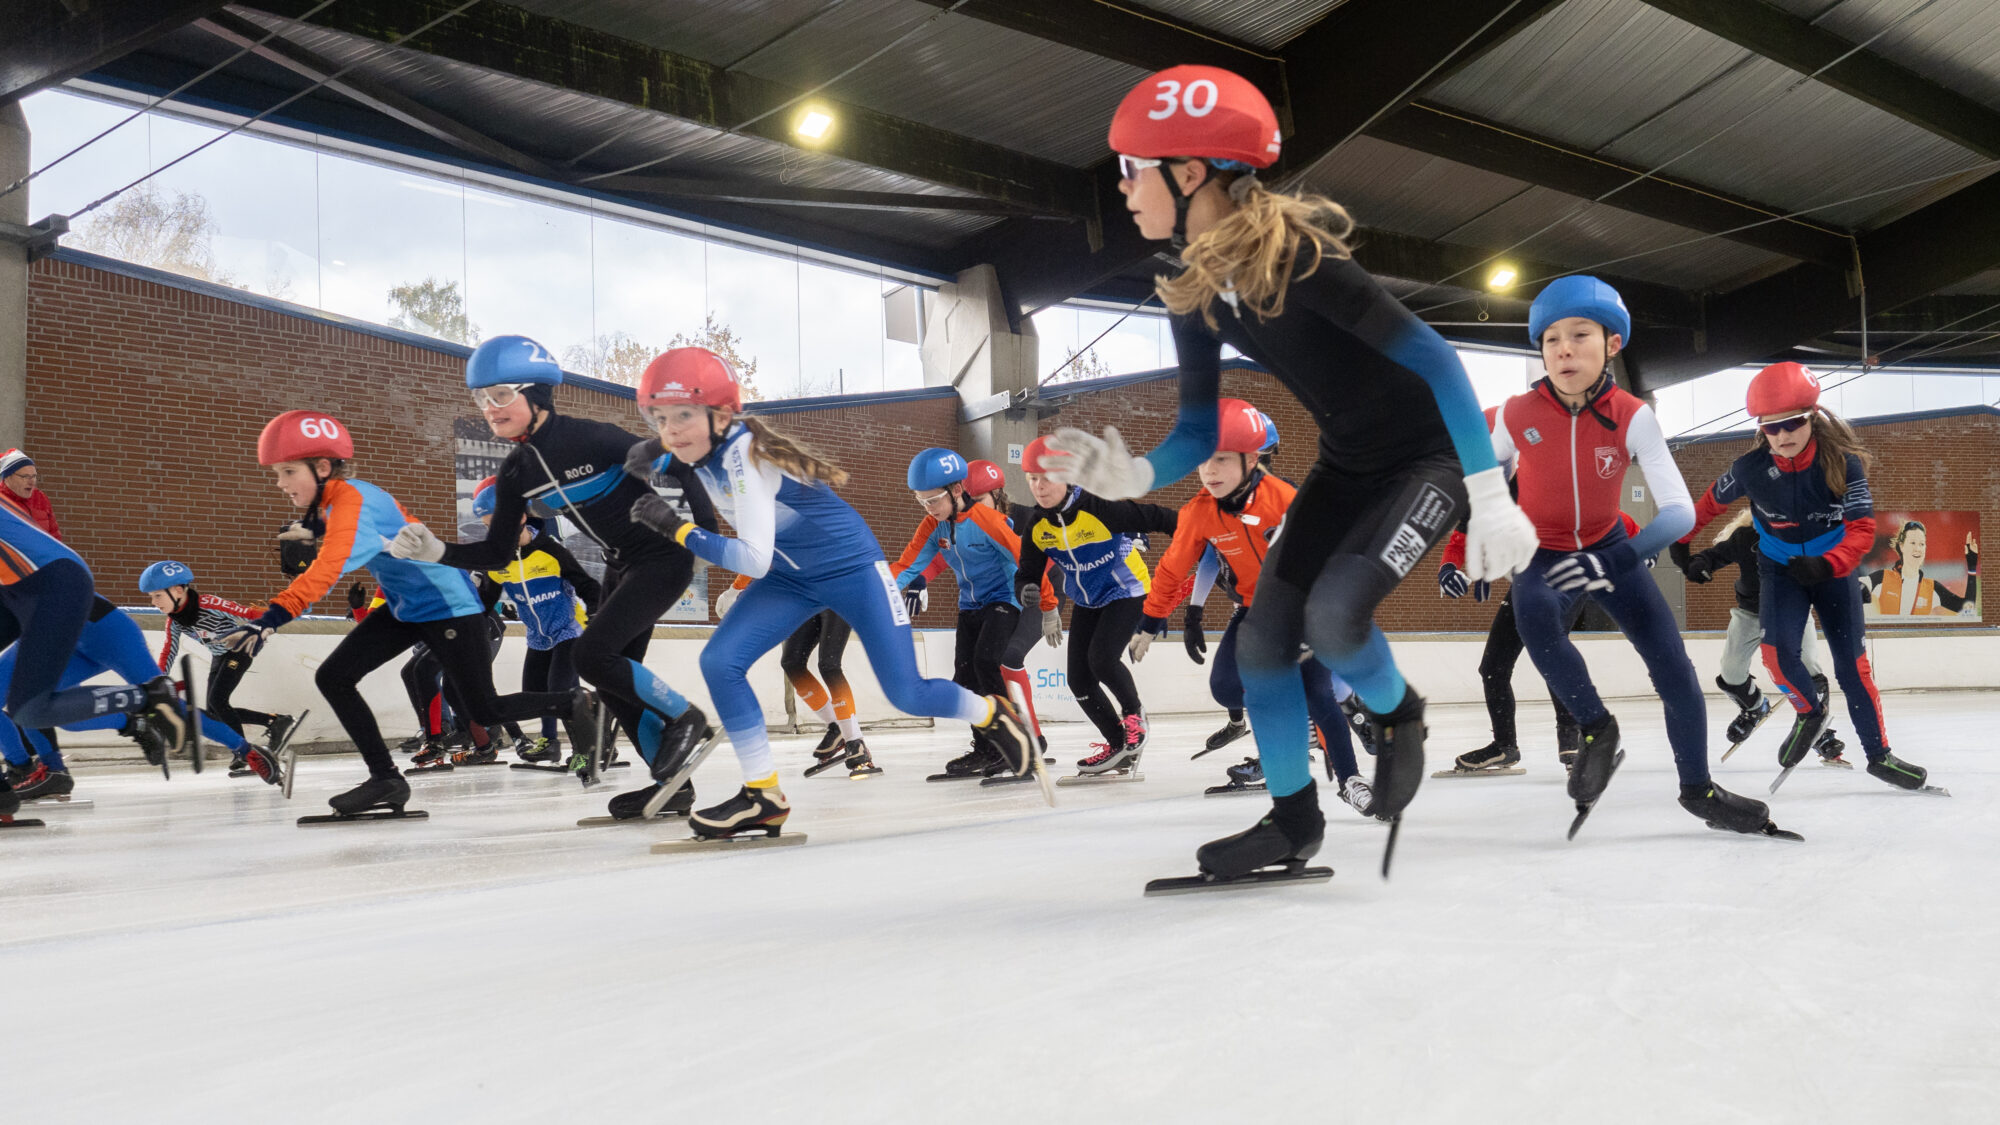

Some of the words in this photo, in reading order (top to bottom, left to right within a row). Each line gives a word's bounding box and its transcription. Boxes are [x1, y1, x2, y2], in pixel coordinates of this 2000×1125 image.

[1146, 79, 1218, 120] 30
[300, 417, 339, 439] 60
[939, 454, 960, 474] 57
[1010, 449, 1021, 459] 19
[564, 463, 594, 480] ROCO
[986, 465, 999, 480] 6
[1387, 529, 1416, 564] PAUL
[162, 562, 184, 577] 65
[1036, 668, 1067, 689] Sch
